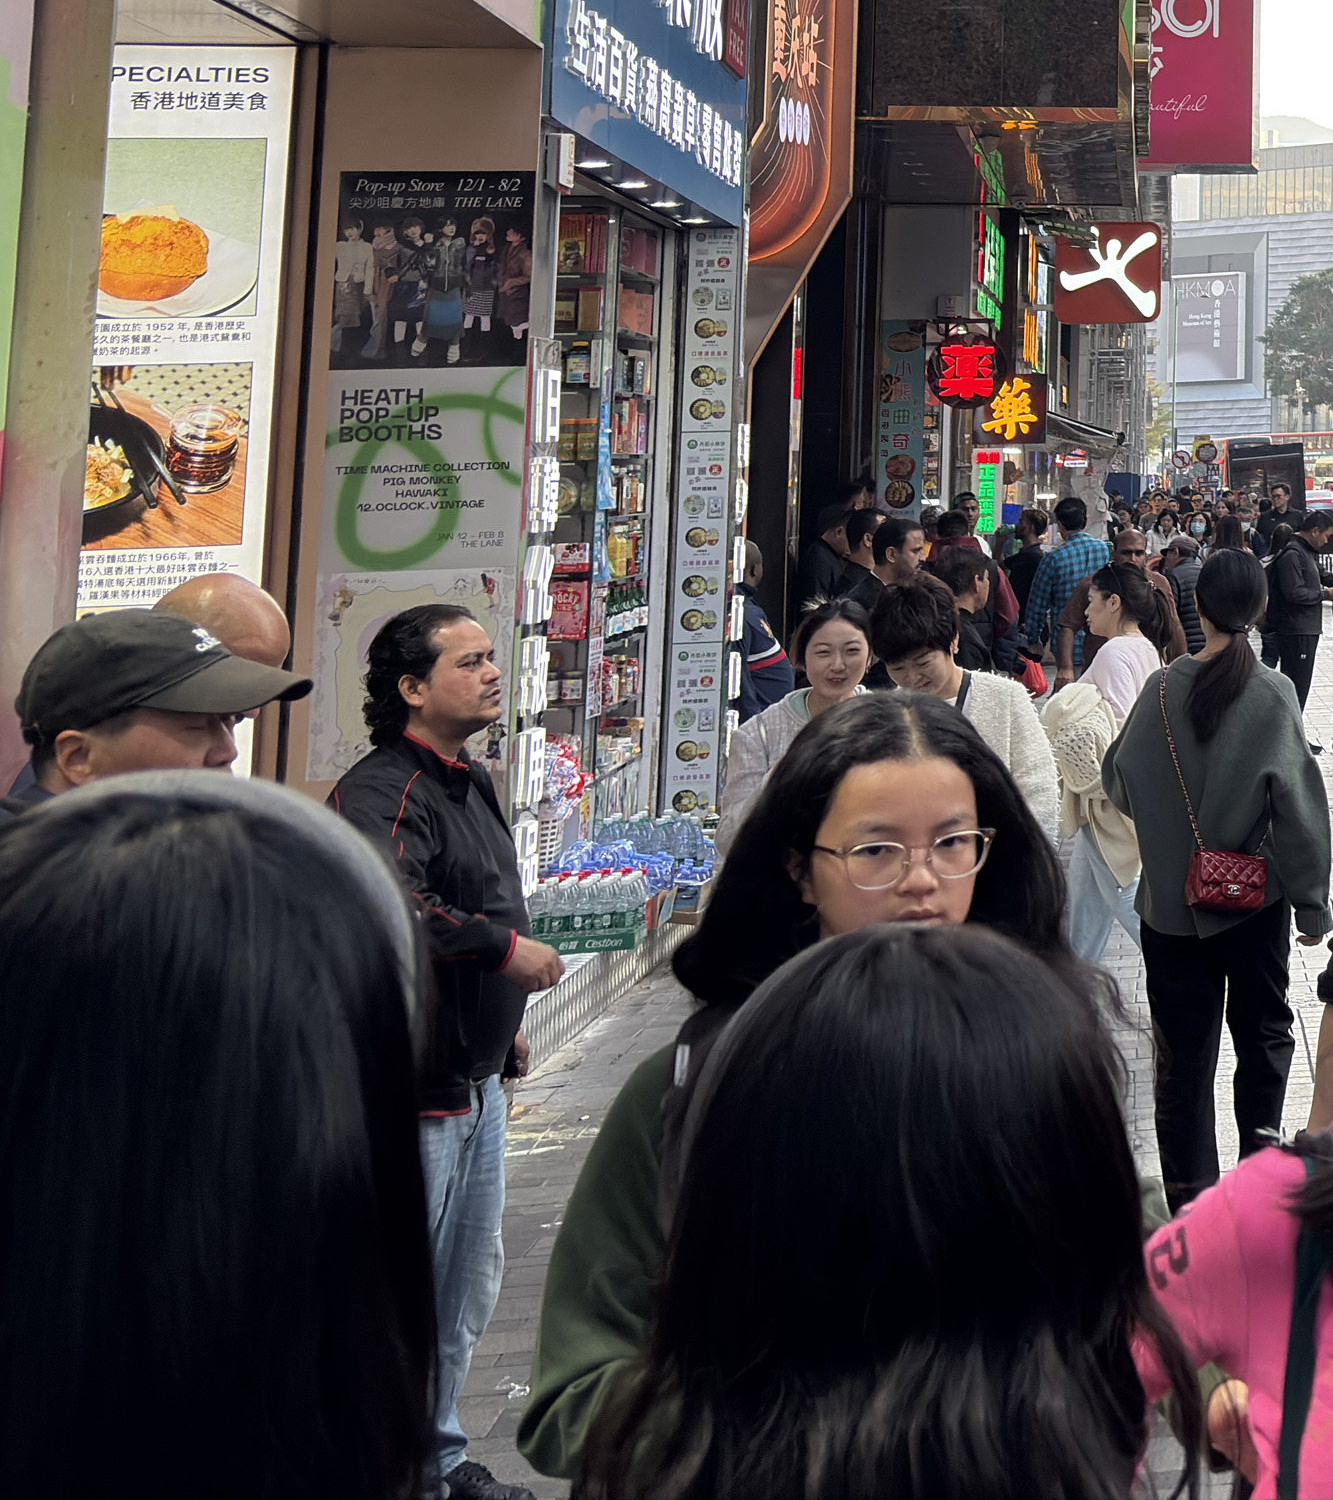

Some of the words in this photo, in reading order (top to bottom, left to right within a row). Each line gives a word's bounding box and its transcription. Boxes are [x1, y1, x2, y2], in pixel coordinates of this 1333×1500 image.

[130, 91, 268, 110] 香港地道美食
[355, 179, 405, 196] Pop-up
[408, 178, 444, 192] Store
[456, 178, 485, 192] 12/1
[498, 178, 521, 192] 8/2
[454, 197, 481, 208] THE
[485, 196, 523, 208] LANE
[145, 323, 174, 331] 1952
[193, 321, 246, 332] 是香港歷史
[341, 388, 423, 406] HEATH
[981, 377, 1038, 440] 藥
[339, 406, 439, 425] POP-UP
[338, 424, 443, 443] BOOTHS
[335, 465, 367, 475] TIME
[370, 463, 430, 474] MACHINE
[433, 461, 510, 471] COLLECTION
[383, 477, 405, 486] PIG
[409, 475, 461, 485] MONKEY
[395, 488, 448, 499] HAWAKI
[437, 532, 454, 541] JAN
[456, 532, 467, 540] 12
[478, 531, 495, 539] FEB
[460, 540, 478, 548] THE
[480, 539, 504, 548] LANE
[559, 940, 578, 950] 怡寶
[585, 937, 623, 949] Cestbon
